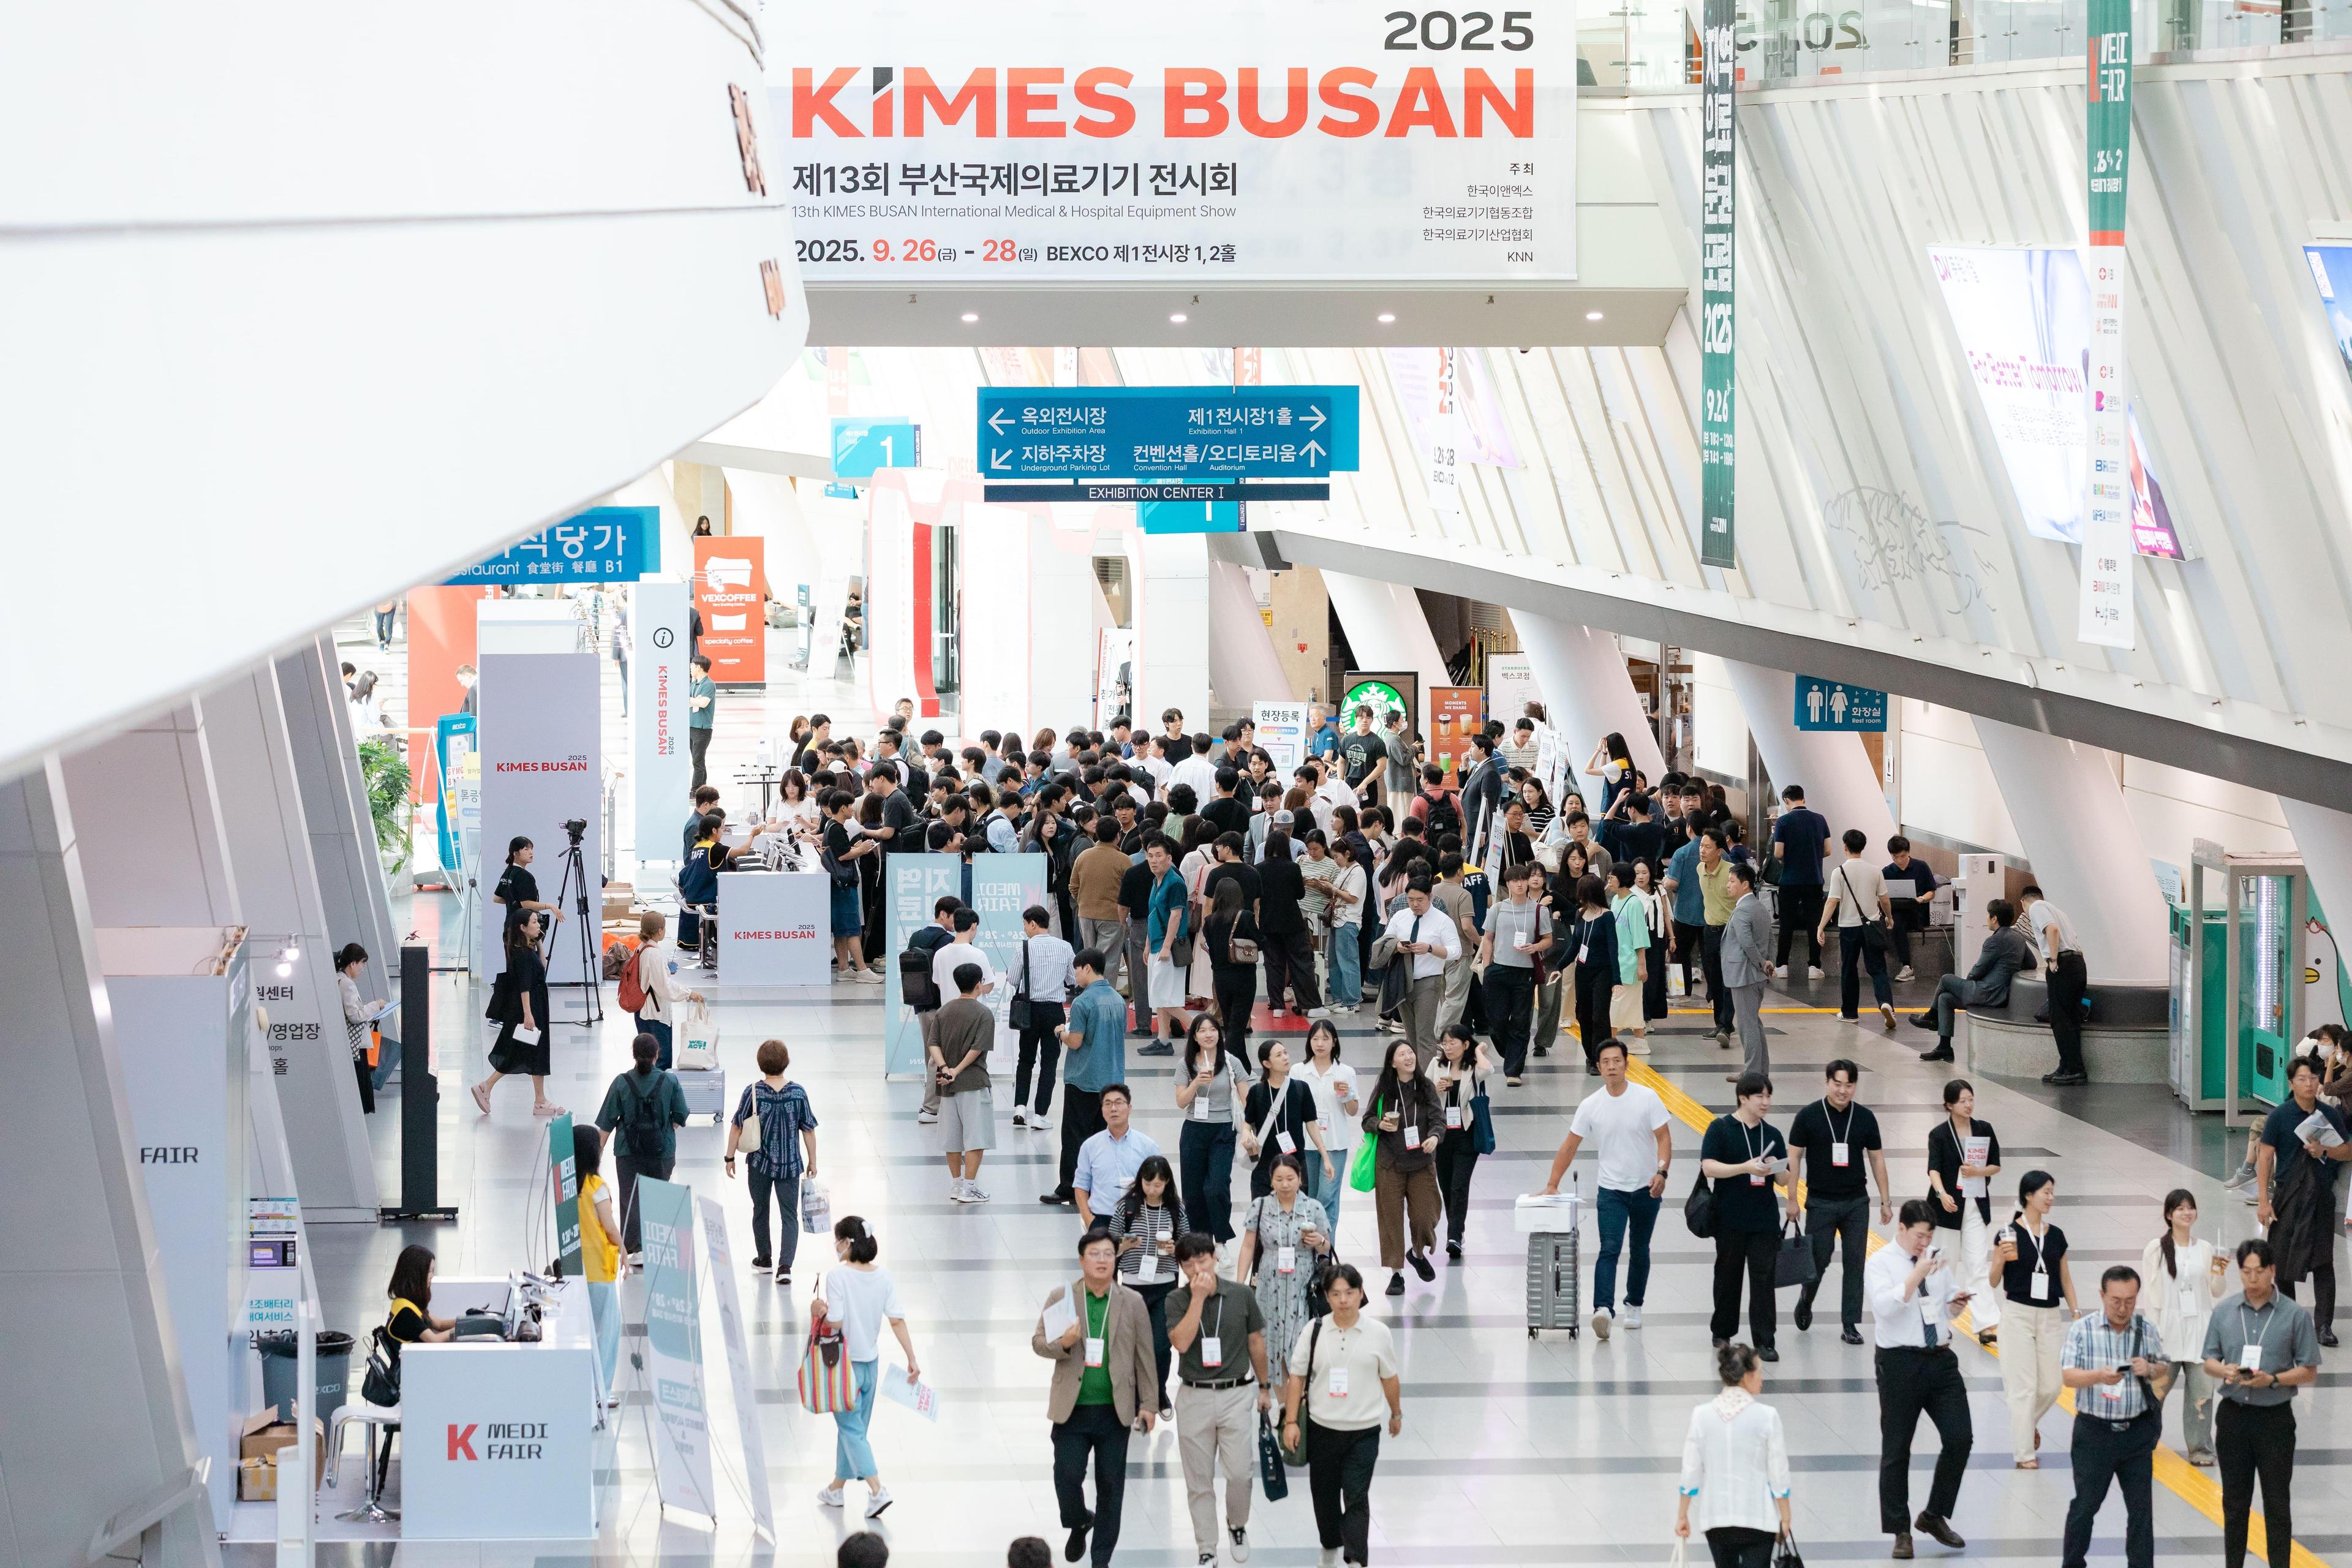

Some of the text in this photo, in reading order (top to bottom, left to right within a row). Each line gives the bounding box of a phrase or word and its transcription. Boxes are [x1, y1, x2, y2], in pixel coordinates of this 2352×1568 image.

[1384, 10, 1534, 51] 2025
[792, 67, 1534, 138] KIMES BUSAN
[793, 162, 1237, 197] 제13회 부산국제의료기기 전시회
[1467, 184, 1534, 198] 한국이앤엑스
[793, 205, 1237, 221] 13th KIMES BUSAN International Medical & Hospital Equipment Show
[1423, 206, 1534, 220] 한국의료기기협동조합
[1423, 228, 1534, 242] 한국의료기기산업협회
[795, 239, 865, 262] 2025.
[873, 239, 895, 262] 9.
[902, 239, 957, 262] 26(금)
[982, 239, 1038, 262] 28(일)
[1047, 246, 1109, 262] BEXCO
[1113, 244, 1190, 263] 제1전시장
[1507, 252, 1534, 262] KNN
[1021, 407, 1106, 426] 옥외전시장
[1022, 444, 1297, 464] 지하주차장 컨벤션홀/오디토리움
[1089, 486, 1224, 499] EXHIBITION CENTER I
[504, 525, 627, 559] 식당가
[451, 561, 520, 576] estaurant
[526, 560, 564, 575] 食堂街
[605, 560, 623, 573] B1
[701, 593, 757, 603] VEXCOFFEE
[1501, 672, 1530, 680] 벡스코점
[658, 665, 668, 755] KIMES BUSAN
[1261, 709, 1300, 723] 현장등록
[1852, 707, 1881, 717] 화장실
[497, 762, 587, 772] KIMES BUSAN
[691, 849, 705, 860] TAFF
[734, 930, 815, 940] KIMES BUSAN
[273, 1057, 288, 1075] 홀
[140, 1147, 199, 1164] FAIR
[447, 1423, 549, 1461] K MEDI
[488, 1444, 542, 1460] FAIR
